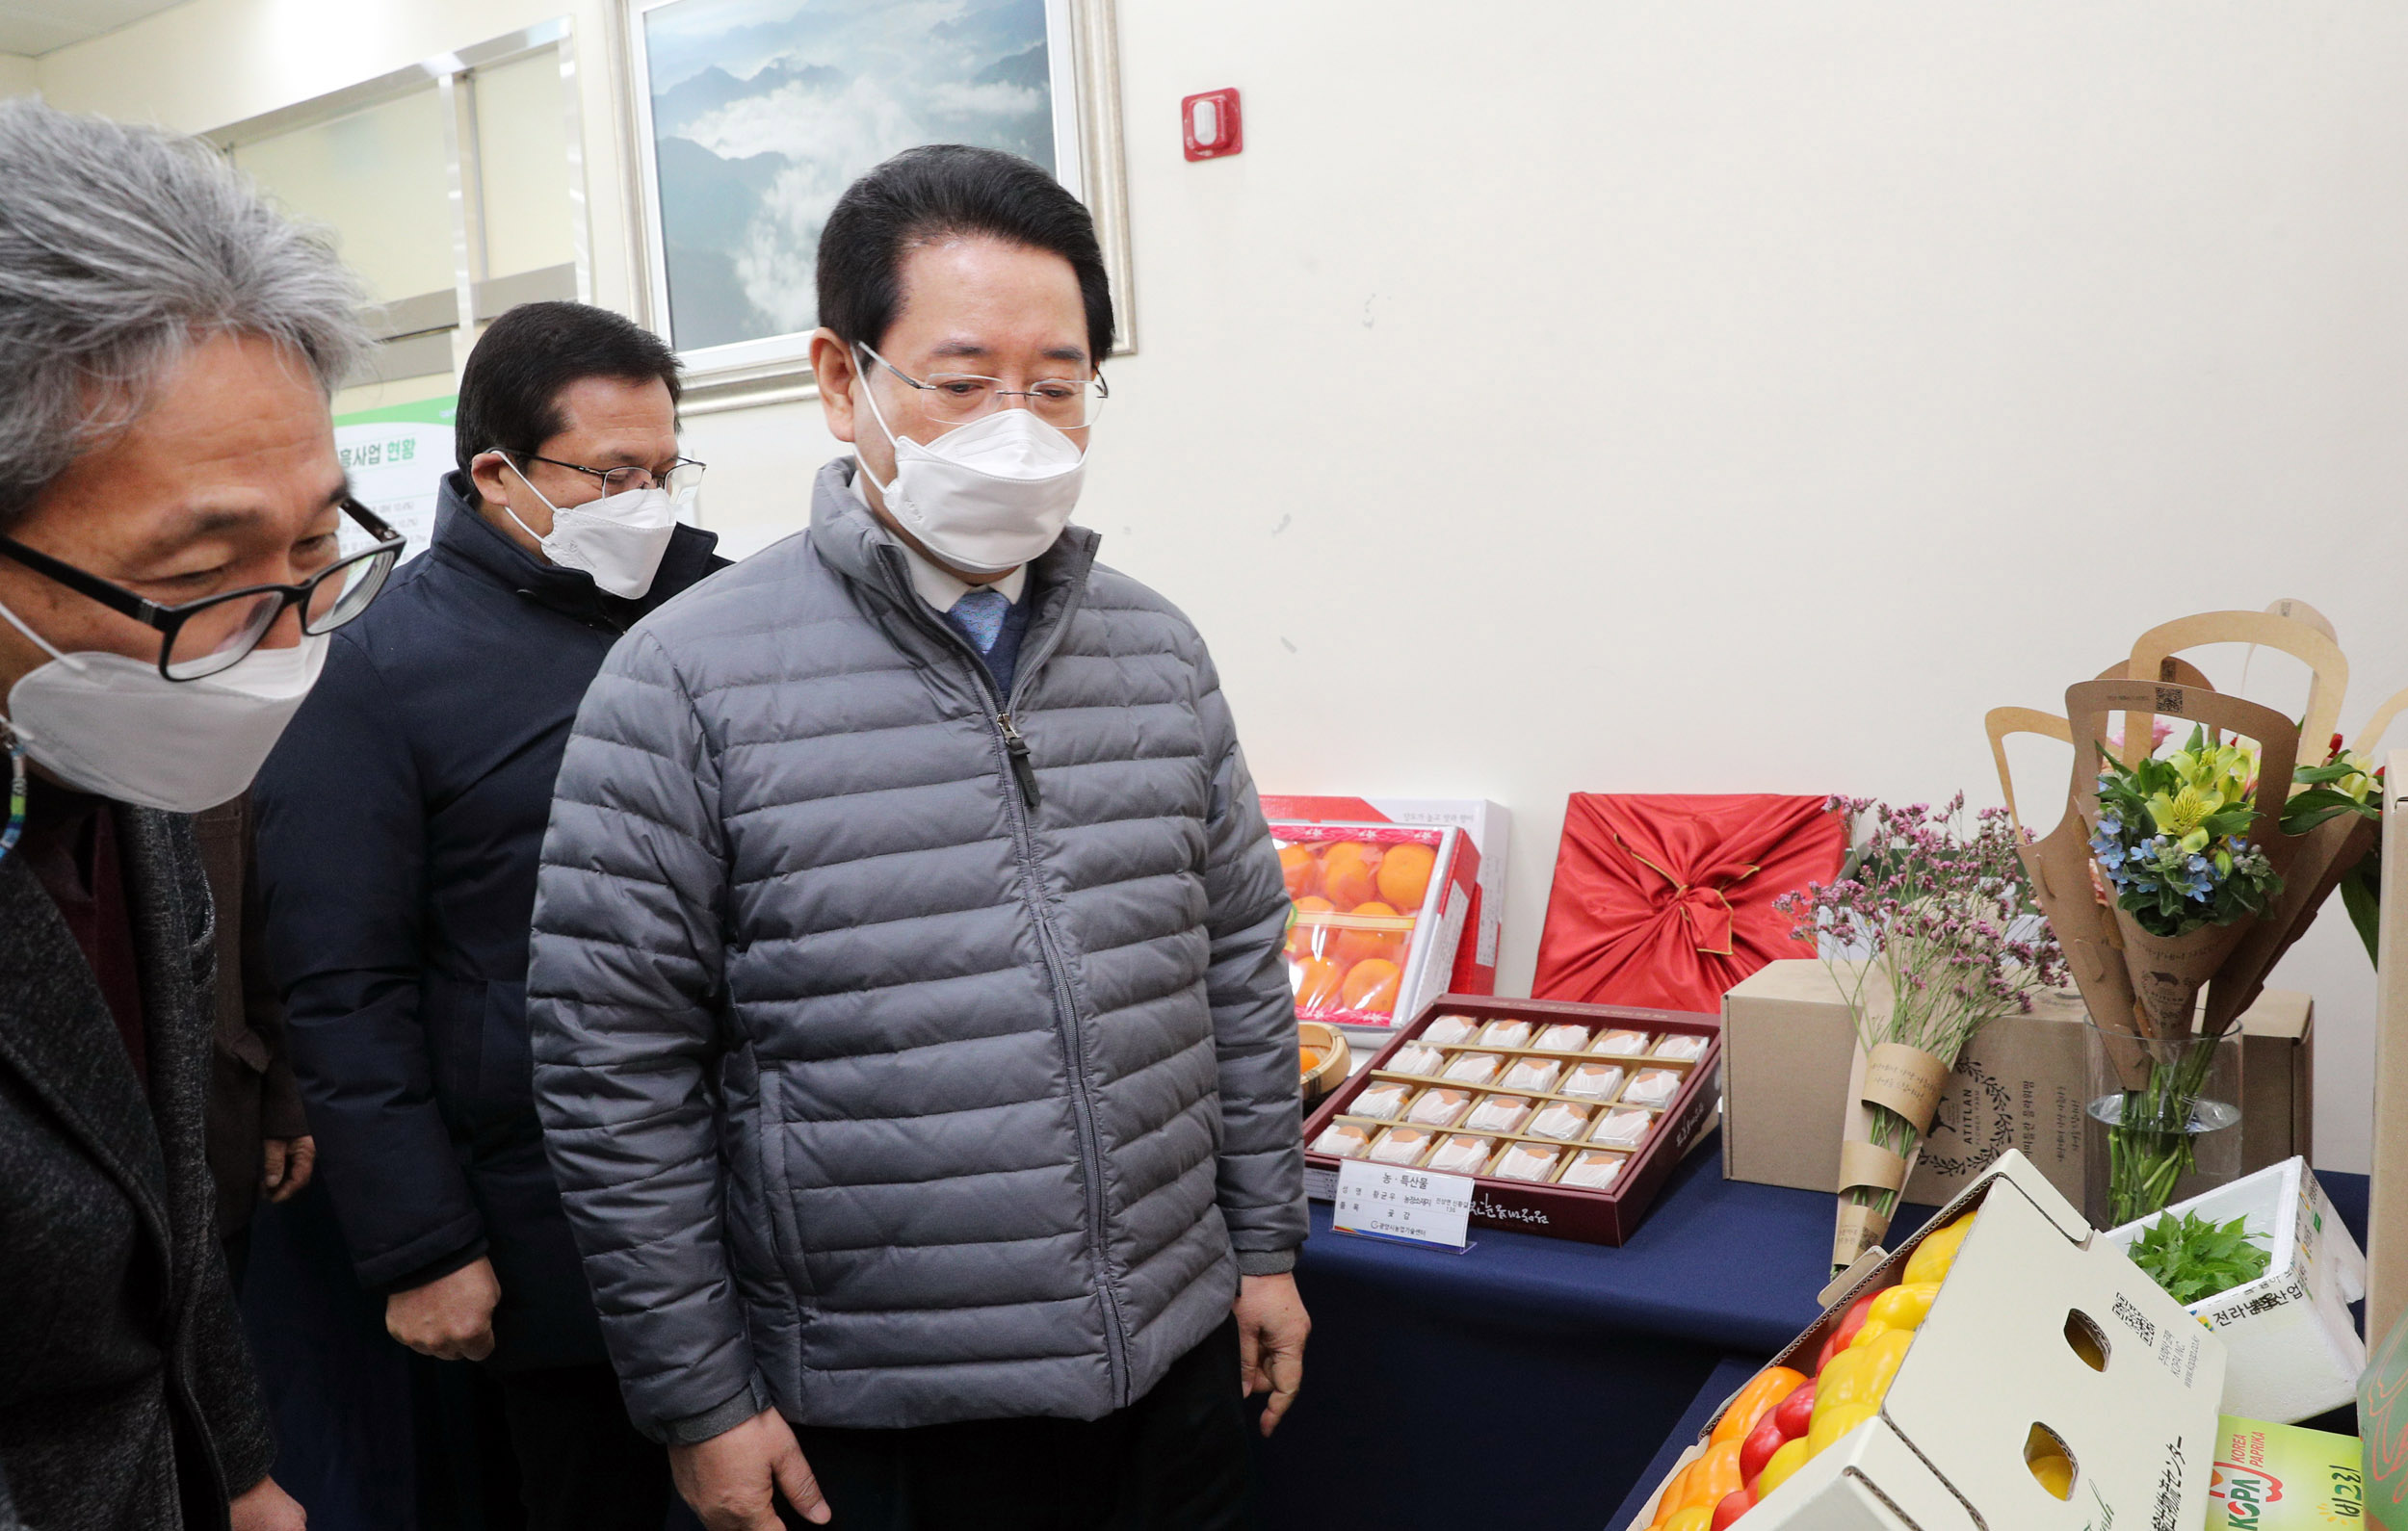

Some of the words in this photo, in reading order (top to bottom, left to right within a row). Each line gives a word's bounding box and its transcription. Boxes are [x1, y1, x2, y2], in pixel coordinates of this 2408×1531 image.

[339, 444, 381, 468] 흥사업
[387, 438, 416, 461] 현황
[1962, 1088, 1974, 1145] ATITLAN
[2231, 1433, 2247, 1465] KOREA
[2249, 1431, 2265, 1468] PAPRIKA
[2227, 1479, 2262, 1531] KOPA
